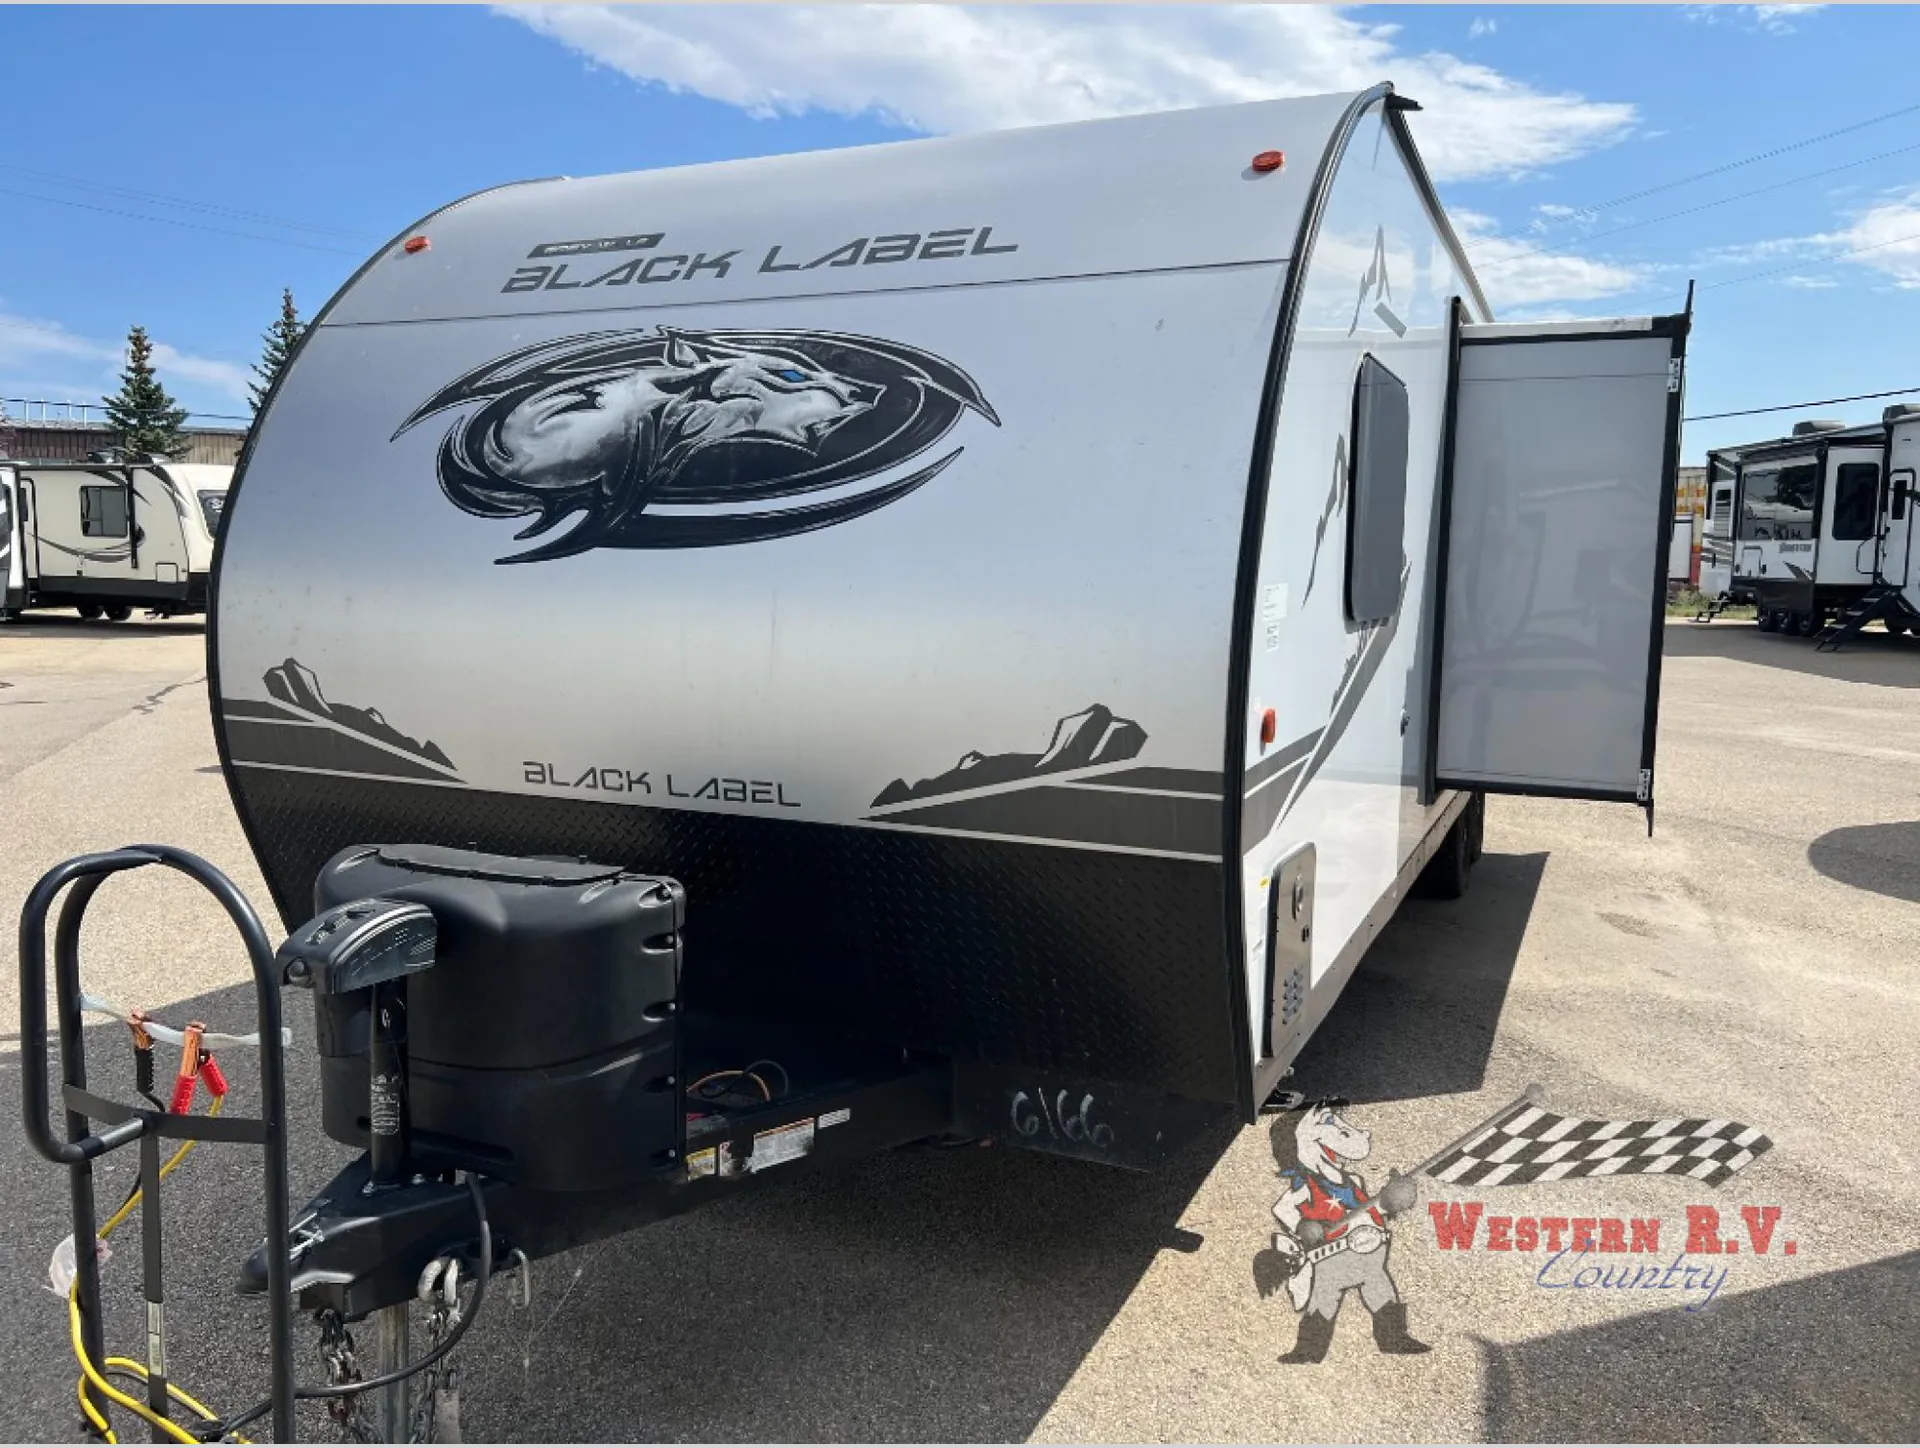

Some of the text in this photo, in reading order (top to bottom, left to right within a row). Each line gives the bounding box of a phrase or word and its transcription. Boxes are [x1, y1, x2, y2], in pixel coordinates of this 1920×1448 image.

[500, 227, 1018, 294] BLACK LABEL
[523, 761, 801, 807] BLACK LABEL
[1010, 1087, 1115, 1147] 6166
